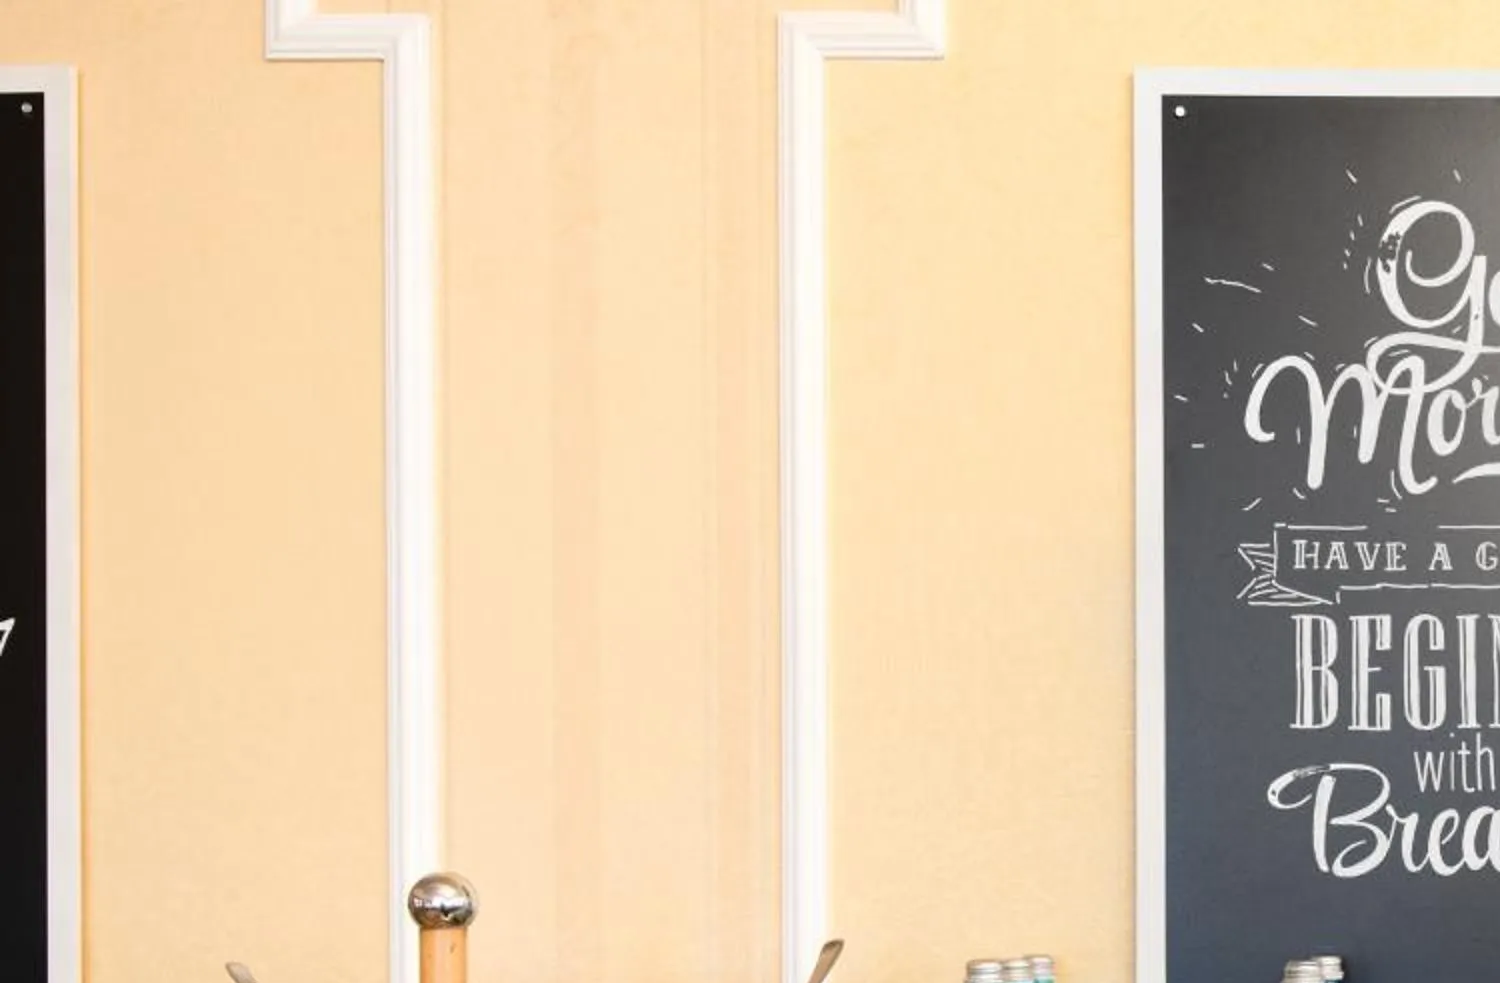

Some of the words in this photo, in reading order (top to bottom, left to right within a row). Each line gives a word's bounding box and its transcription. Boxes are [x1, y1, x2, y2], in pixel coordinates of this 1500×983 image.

[1292, 540, 1407, 570] HAVE
[1429, 541, 1453, 571] A
[1413, 732, 1497, 793] with
